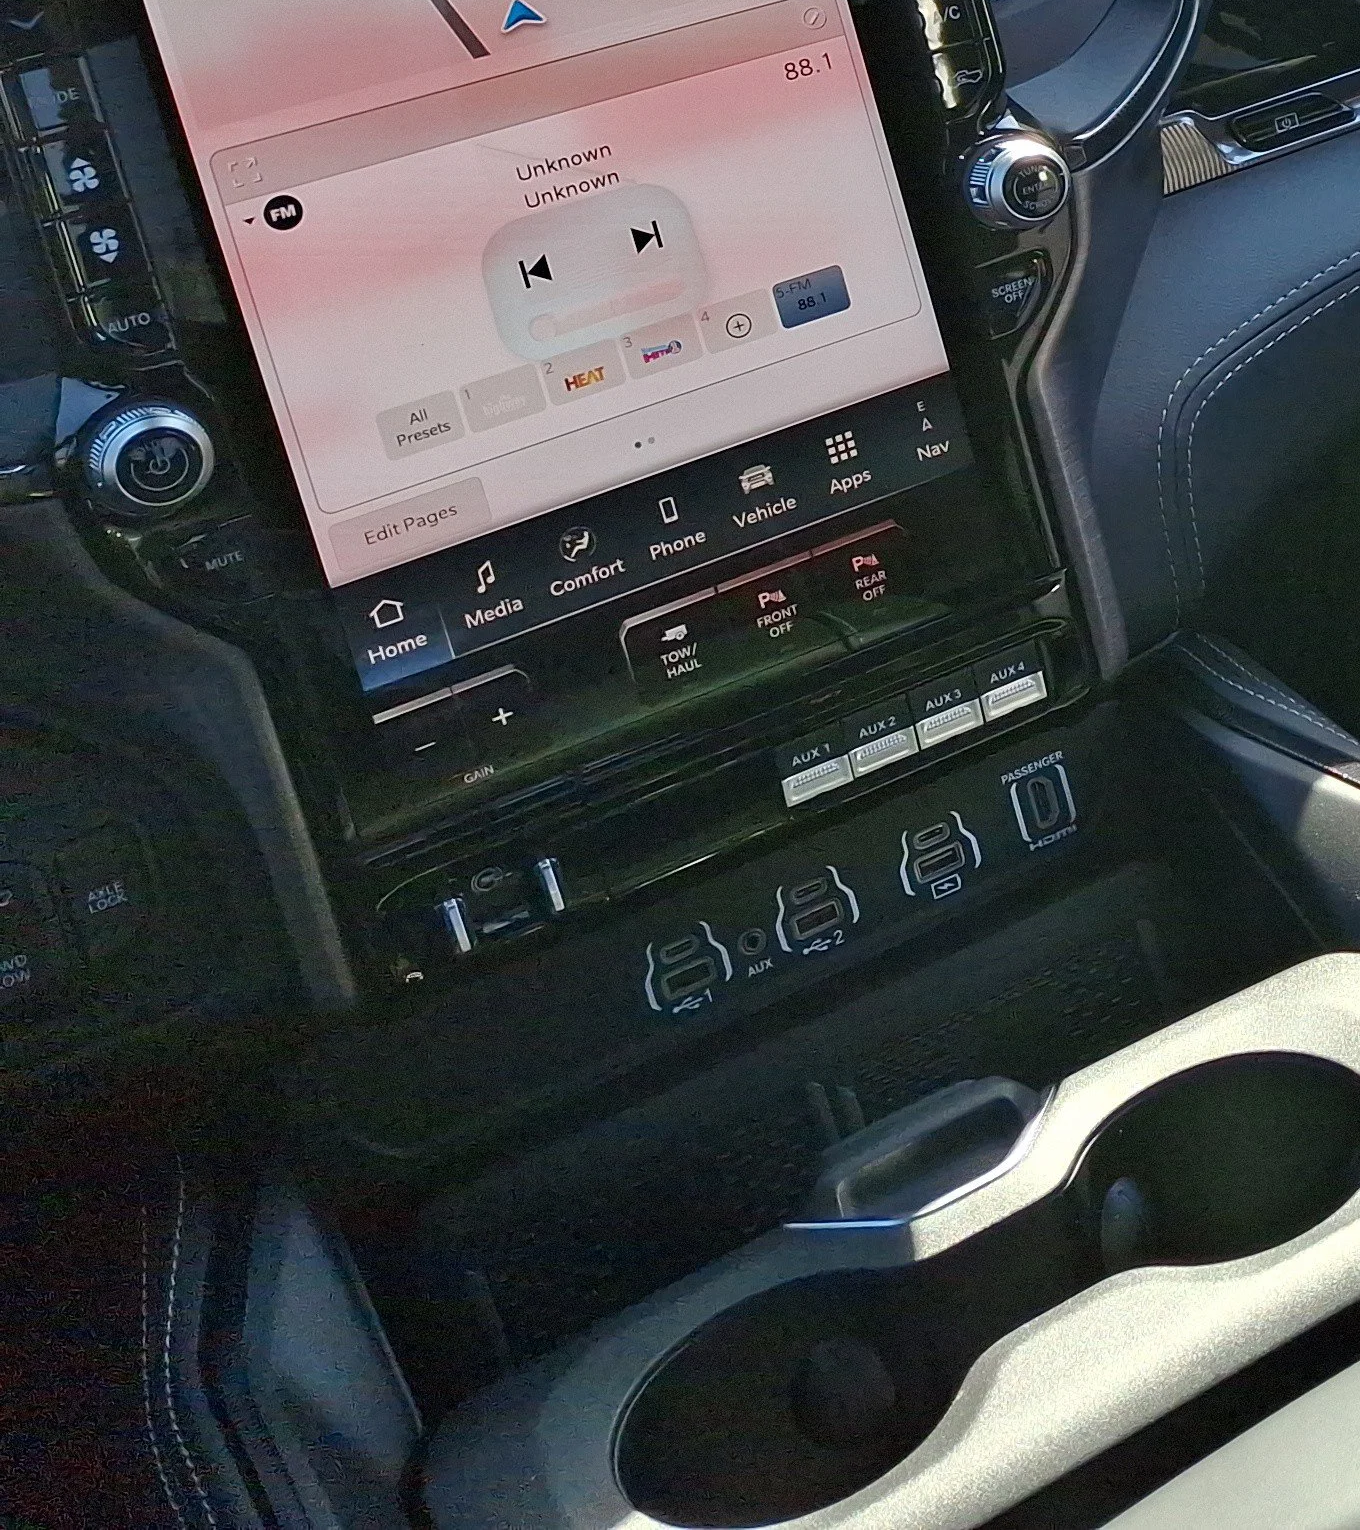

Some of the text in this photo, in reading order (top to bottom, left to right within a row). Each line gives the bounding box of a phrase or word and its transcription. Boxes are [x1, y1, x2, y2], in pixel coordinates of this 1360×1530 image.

[785, 52, 834, 83] 88.1
[516, 141, 613, 183] Unknown
[524, 169, 621, 210] Unknown
[270, 204, 297, 223] FM
[991, 278, 1034, 299] SCREEN
[1004, 291, 1024, 304] OFF
[798, 292, 827, 311] 88.1
[107, 311, 152, 336] AUTO
[700, 310, 711, 325] 4
[623, 336, 633, 349] 3
[544, 361, 555, 376] 2
[563, 366, 605, 392] HEAT
[409, 408, 429, 427] All
[916, 401, 926, 412] E
[396, 419, 452, 448] Presets
[916, 440, 950, 461] Nav
[829, 469, 872, 497] Apps
[732, 495, 798, 529] Vehicle
[364, 503, 458, 546] Edit Pages
[648, 529, 706, 561] Phone
[205, 549, 244, 572] MUTE
[550, 559, 625, 597] Comfort
[855, 571, 888, 592] REAR
[862, 584, 887, 603] OFF
[464, 595, 523, 628] Media
[756, 604, 799, 629] FRONT
[769, 621, 795, 639] OFF
[367, 631, 428, 664] Home
[660, 643, 697, 667] TOW/
[666, 657, 702, 679] HAUL
[989, 661, 1026, 684] AUX 4
[924, 688, 962, 711] AUX 3
[858, 716, 896, 738] AUX 2
[791, 748, 820, 767] AUX
[1000, 750, 1064, 785] PASSENGER
[464, 765, 495, 784] GAIN
[88, 881, 124, 902] AXLE
[88, 891, 128, 915] LOCK
[833, 929, 845, 945] 2
[0, 954, 27, 973] WD
[747, 958, 774, 978] AUX
